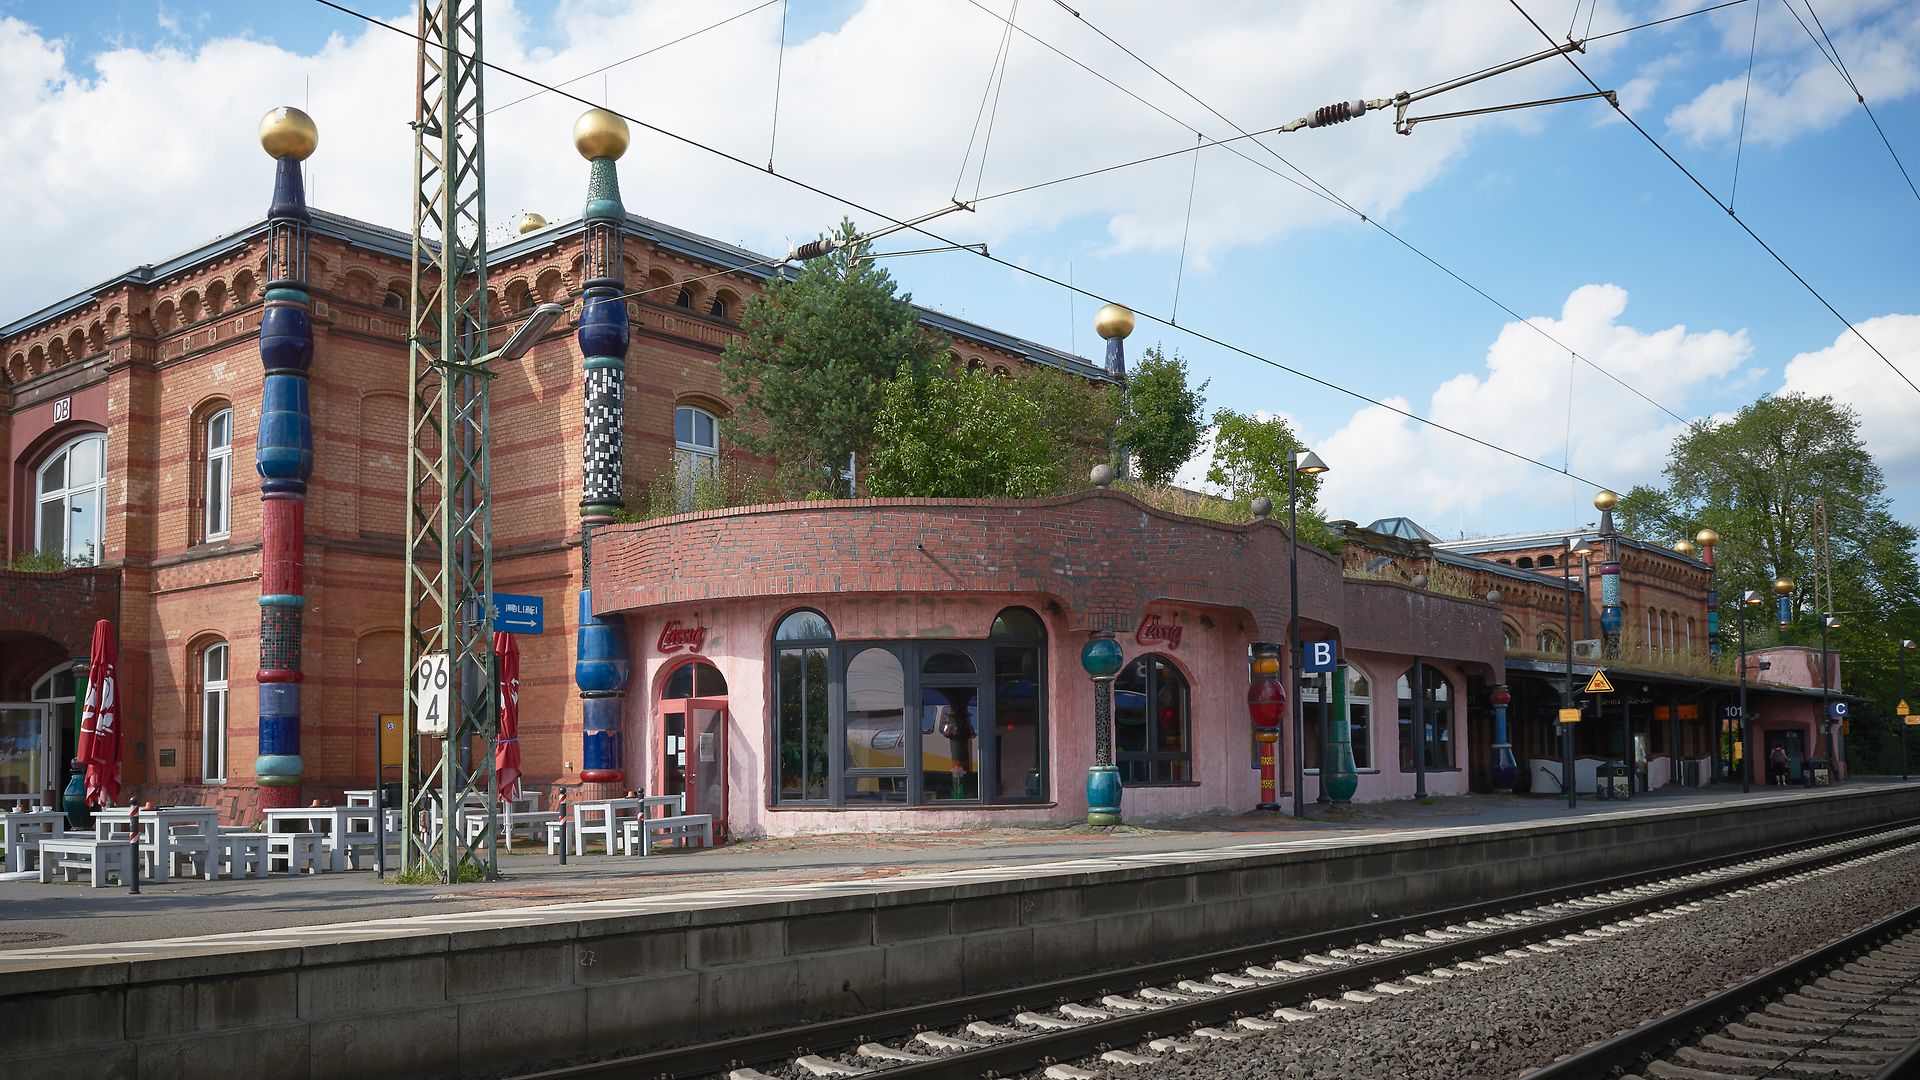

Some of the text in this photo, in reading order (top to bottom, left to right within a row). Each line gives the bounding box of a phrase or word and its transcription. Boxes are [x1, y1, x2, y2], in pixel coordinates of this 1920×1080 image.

[55, 400, 69, 421] DB
[505, 603, 538, 615] POLIZEI
[657, 612, 704, 654] Lässig
[1136, 612, 1184, 650] Lässig
[1314, 642, 1331, 666] B
[420, 657, 448, 691] 96
[425, 693, 440, 726] 4
[1725, 706, 1743, 717] 101
[1835, 702, 1846, 715] C
[580, 949, 597, 967] 27
